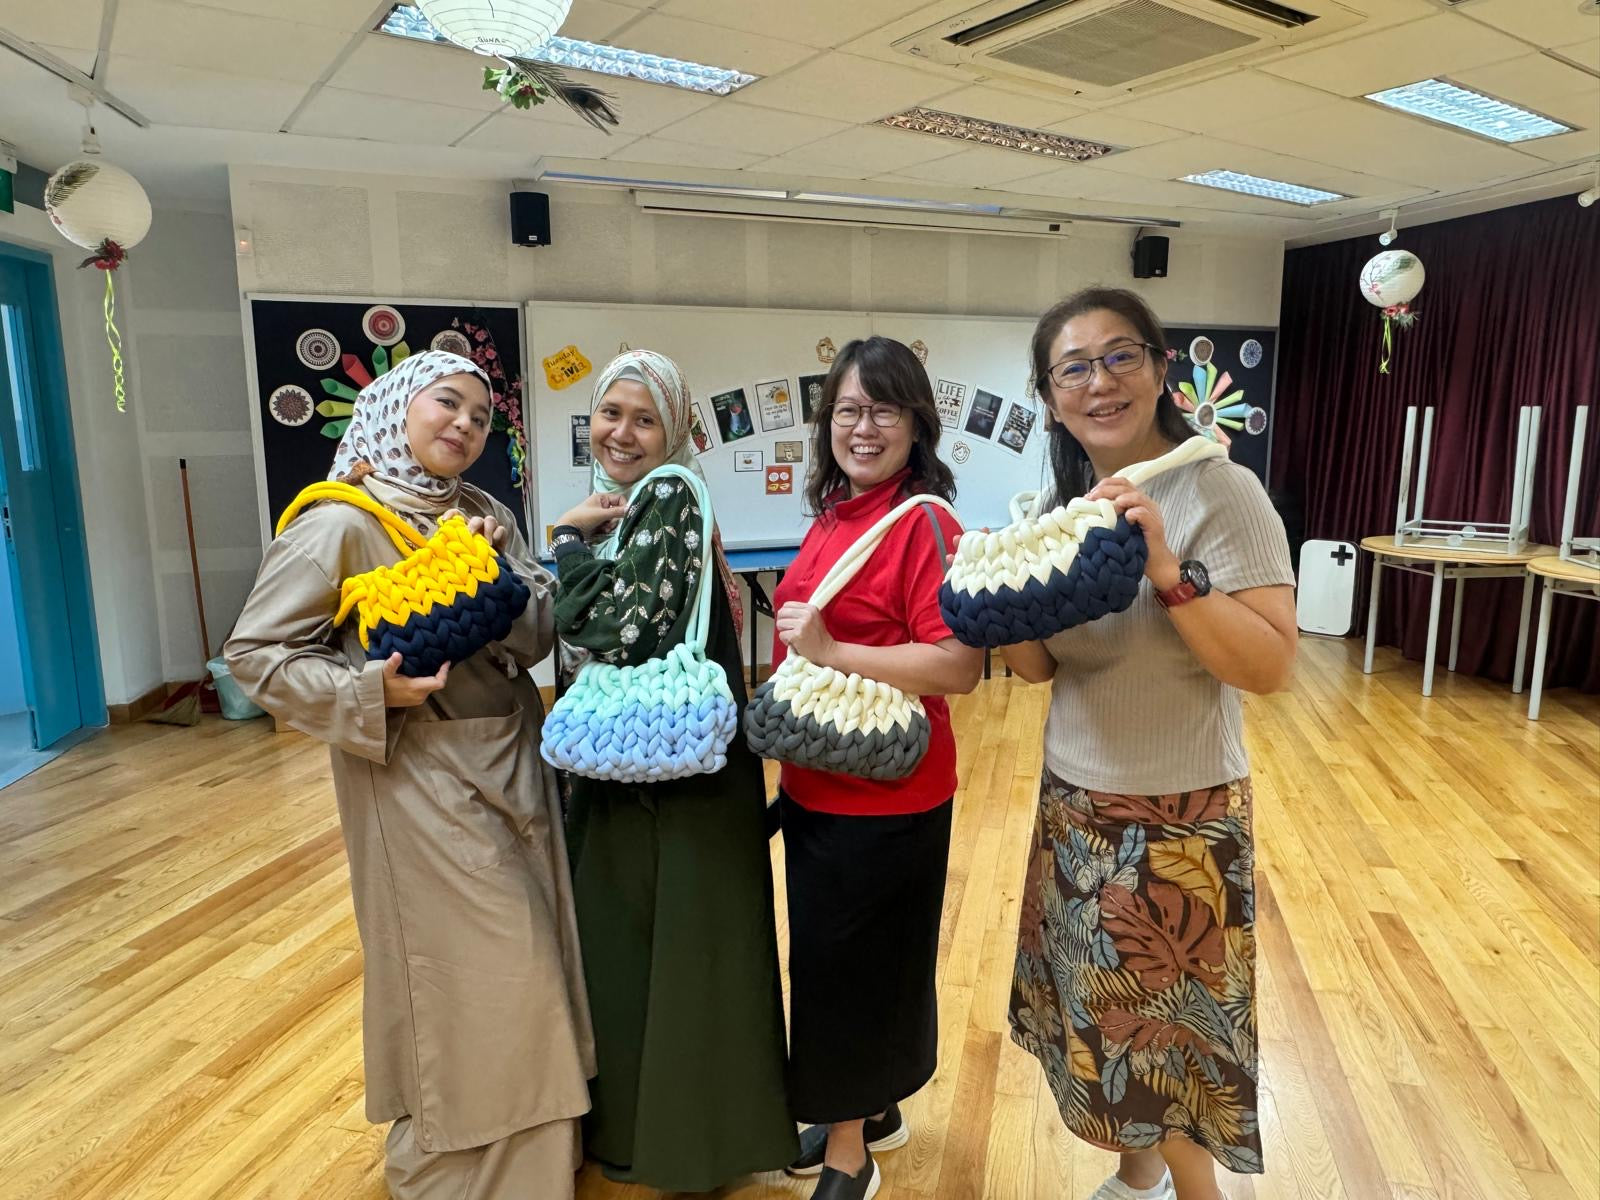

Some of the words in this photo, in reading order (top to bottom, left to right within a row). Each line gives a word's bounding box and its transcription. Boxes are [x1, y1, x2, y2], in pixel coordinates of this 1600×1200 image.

[550, 361, 586, 382] trivia
[938, 383, 963, 397] LIFE
[936, 406, 958, 417] COFFEE
